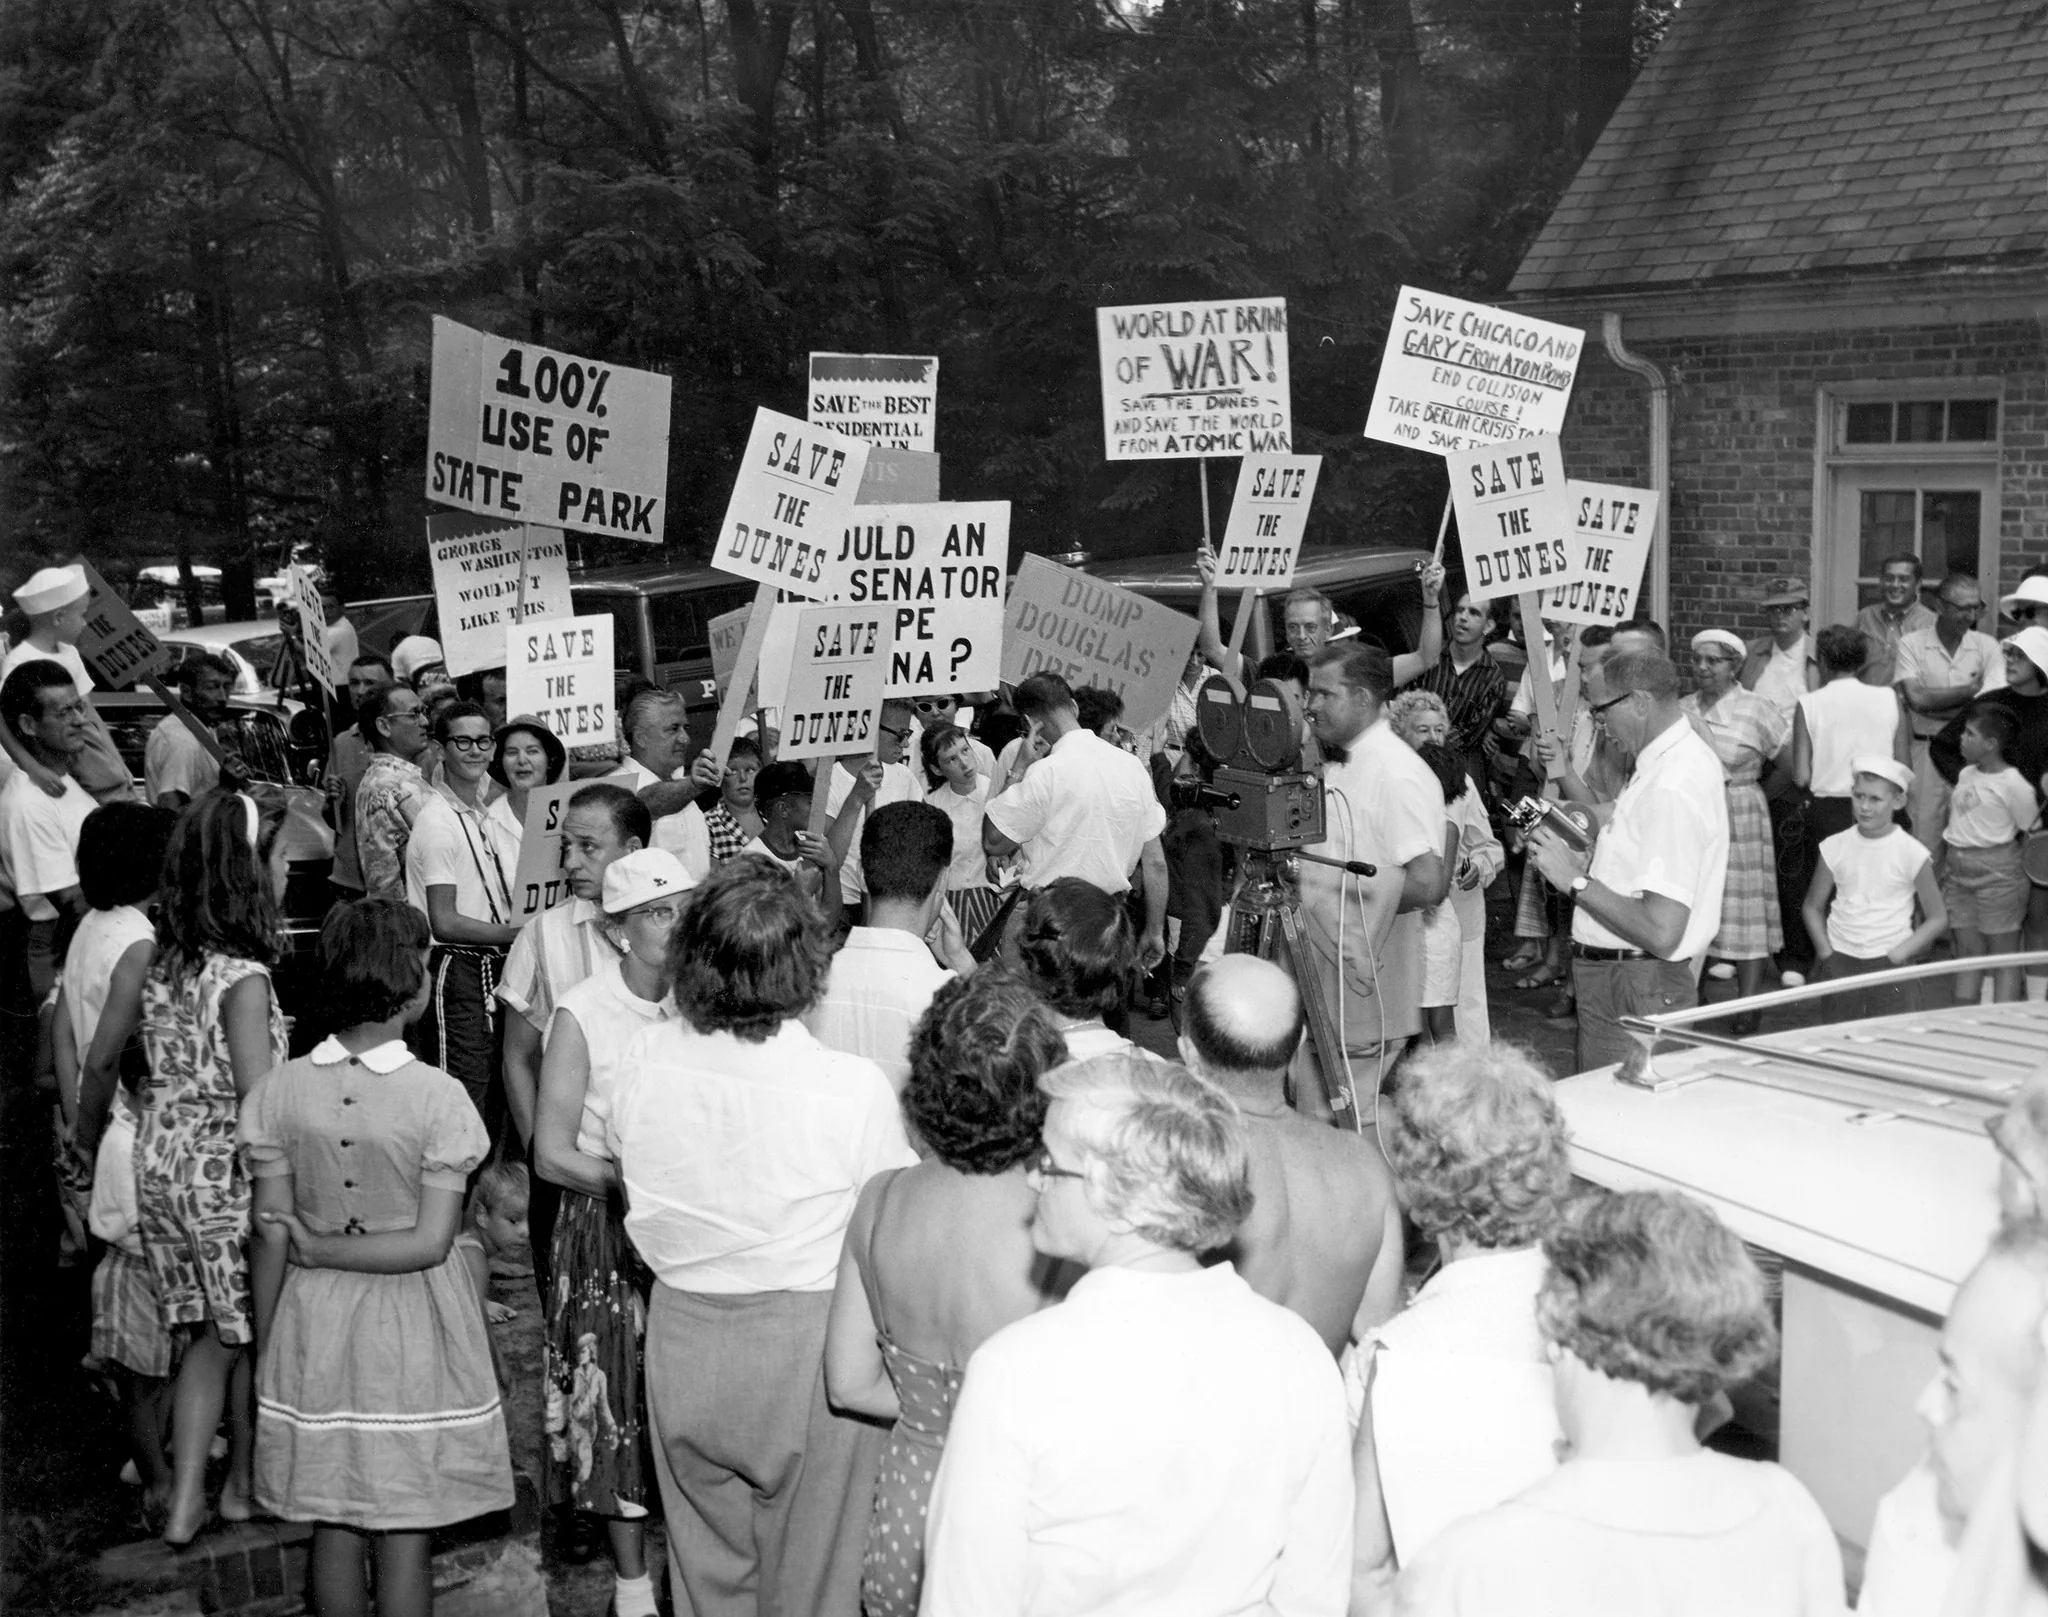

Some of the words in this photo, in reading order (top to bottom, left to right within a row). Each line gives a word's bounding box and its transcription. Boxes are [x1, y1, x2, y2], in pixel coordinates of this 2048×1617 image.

[1112, 310, 1195, 340] WORLD
[1200, 308, 1228, 335] AT
[1404, 297, 1456, 331] SAVE
[1538, 336, 1577, 361] AND
[1116, 356, 1152, 384] OF
[1159, 334, 1278, 390] WAR!
[1403, 329, 1460, 359] GARY
[1457, 341, 1501, 371] FROM
[496, 349, 611, 418] 100%
[1432, 366, 1462, 387] END
[1466, 375, 1545, 405] COLLISION
[813, 394, 860, 413] SAVE
[862, 400, 881, 410] THE
[884, 396, 931, 414] BEST
[1120, 398, 1157, 412] SAVE
[1164, 397, 1193, 411] THE
[1206, 395, 1259, 410] DUNES
[1388, 396, 1421, 418] TAKE
[1422, 403, 1471, 430] BERLIN
[1472, 416, 1514, 440] CRISIS
[482, 404, 553, 456] USE
[566, 423, 610, 464] OF
[1113, 416, 1142, 435] AND
[1145, 416, 1178, 433] SAVE
[1188, 415, 1220, 432] THE
[1229, 412, 1283, 431] WORLD
[1393, 422, 1421, 440] AND
[1429, 430, 1462, 450] SAVE
[1118, 438, 1159, 454] FROM
[1164, 432, 1243, 453] ATOMIC
[1250, 429, 1292, 452] WAR
[767, 432, 846, 487] SAVE
[1471, 451, 1544, 498] SAVE
[432, 451, 522, 512] STATE
[558, 482, 657, 534] PARK
[1251, 467, 1305, 498] SAVE
[774, 493, 810, 527] THE
[1256, 514, 1281, 537] THE
[1497, 508, 1532, 537] THE
[1577, 497, 1640, 534] SAVE
[437, 537, 502, 562] GEORGE
[728, 522, 827, 582] DUNES
[942, 523, 986, 557] AN
[1224, 546, 1291, 577] DUNES
[1475, 539, 1567, 587] DUNES
[1585, 546, 1613, 573] THE
[850, 566, 999, 601] SENATOR
[1552, 582, 1629, 618] DUNES
[1060, 577, 1144, 629] DUMP
[88, 614, 116, 639] THE
[460, 611, 500, 631] LIKE
[96, 629, 157, 678] DUNES
[528, 629, 594, 663] SAVE
[814, 621, 878, 657] SAVE
[1015, 601, 1155, 678] DOUGLAS
[546, 675, 575, 699] THE
[825, 674, 852, 700] THE
[790, 709, 871, 746] DUNES
